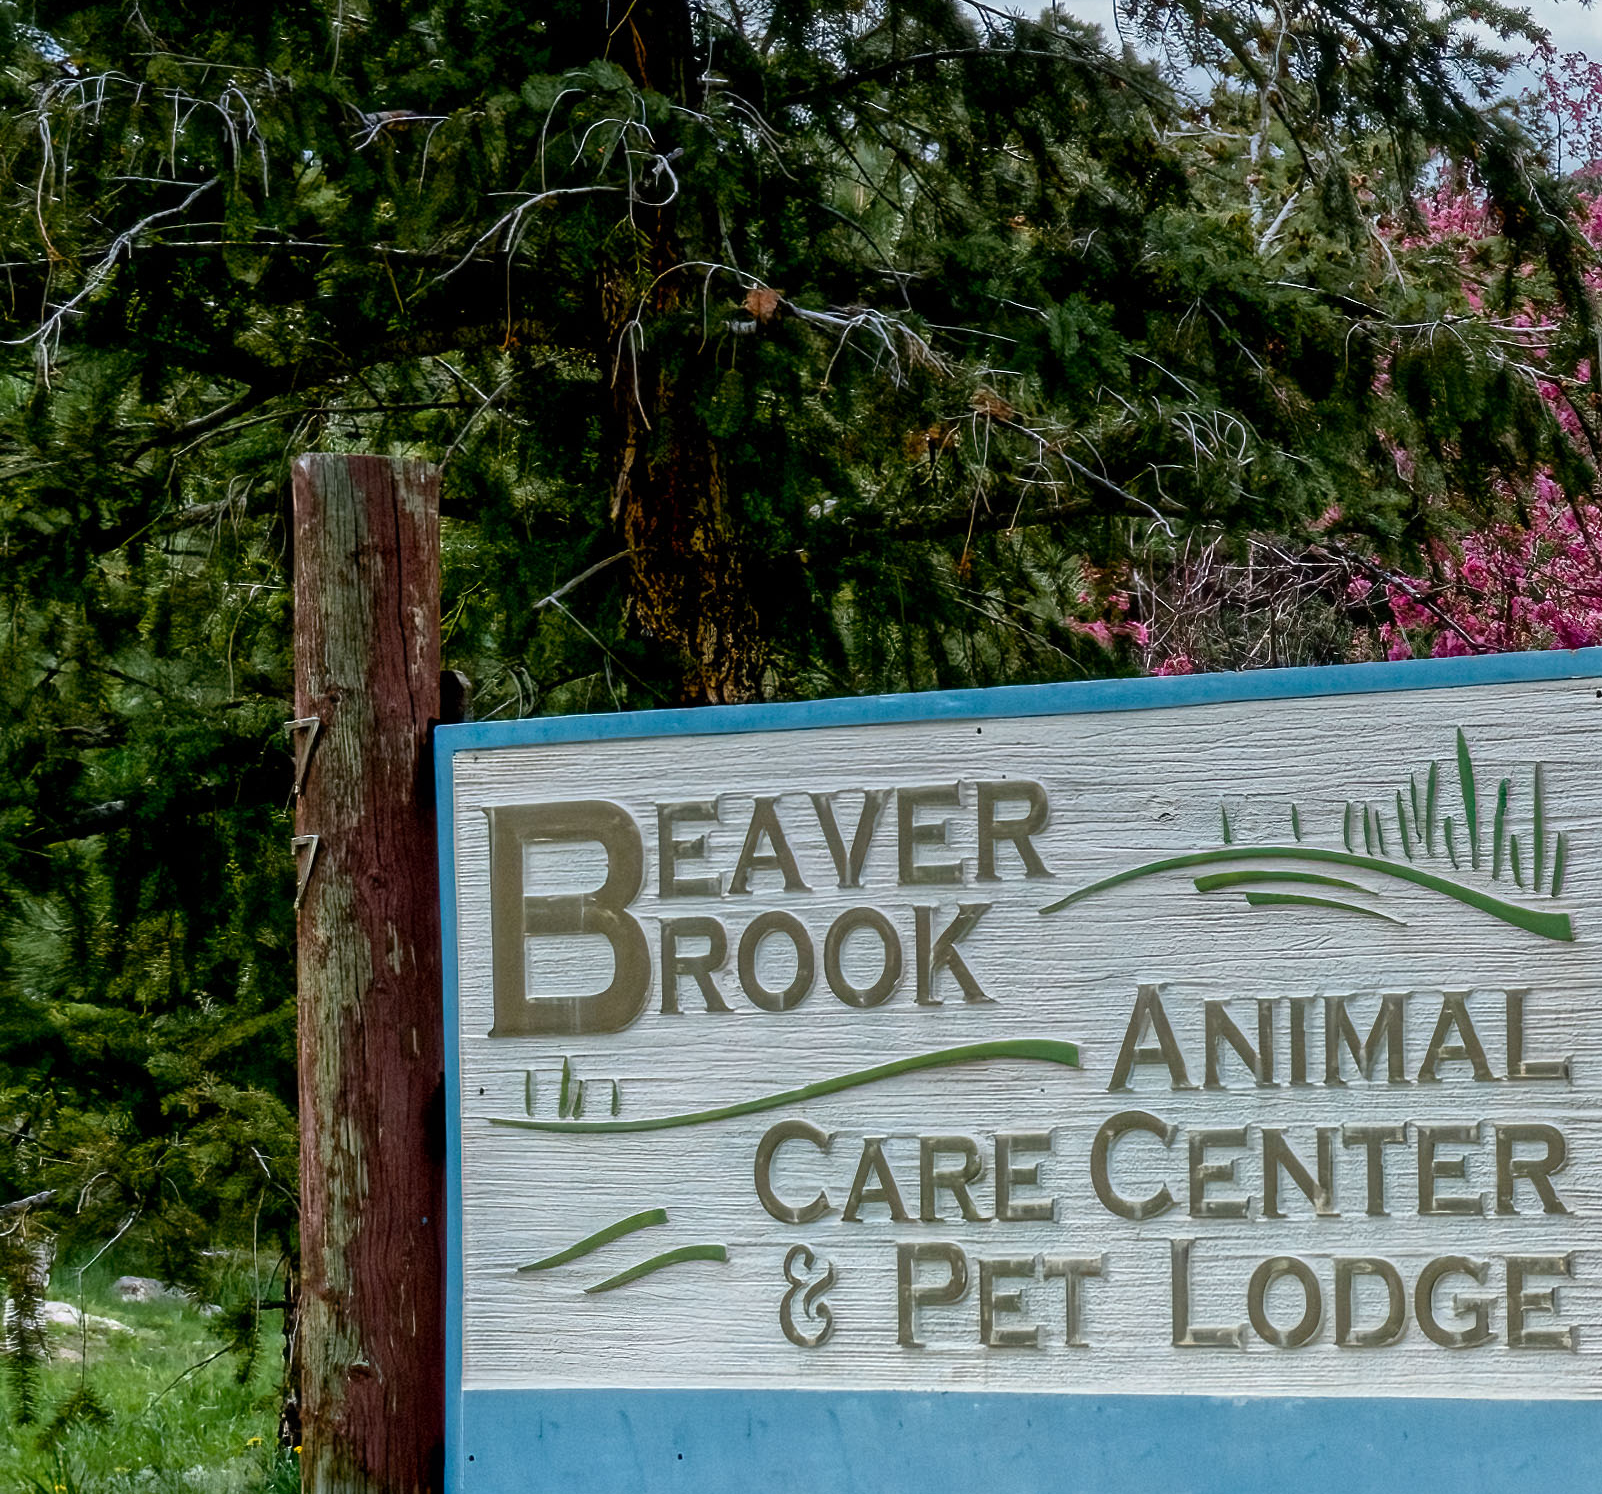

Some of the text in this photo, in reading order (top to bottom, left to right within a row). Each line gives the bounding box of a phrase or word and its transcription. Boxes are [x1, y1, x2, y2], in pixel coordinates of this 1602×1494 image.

[482, 778, 1056, 1037] BEAVER
[1107, 983, 1574, 1091] ANIMAL
[754, 1109, 1575, 1224] CARE CENTER
[779, 1237, 1579, 1353] & PET LODGE
